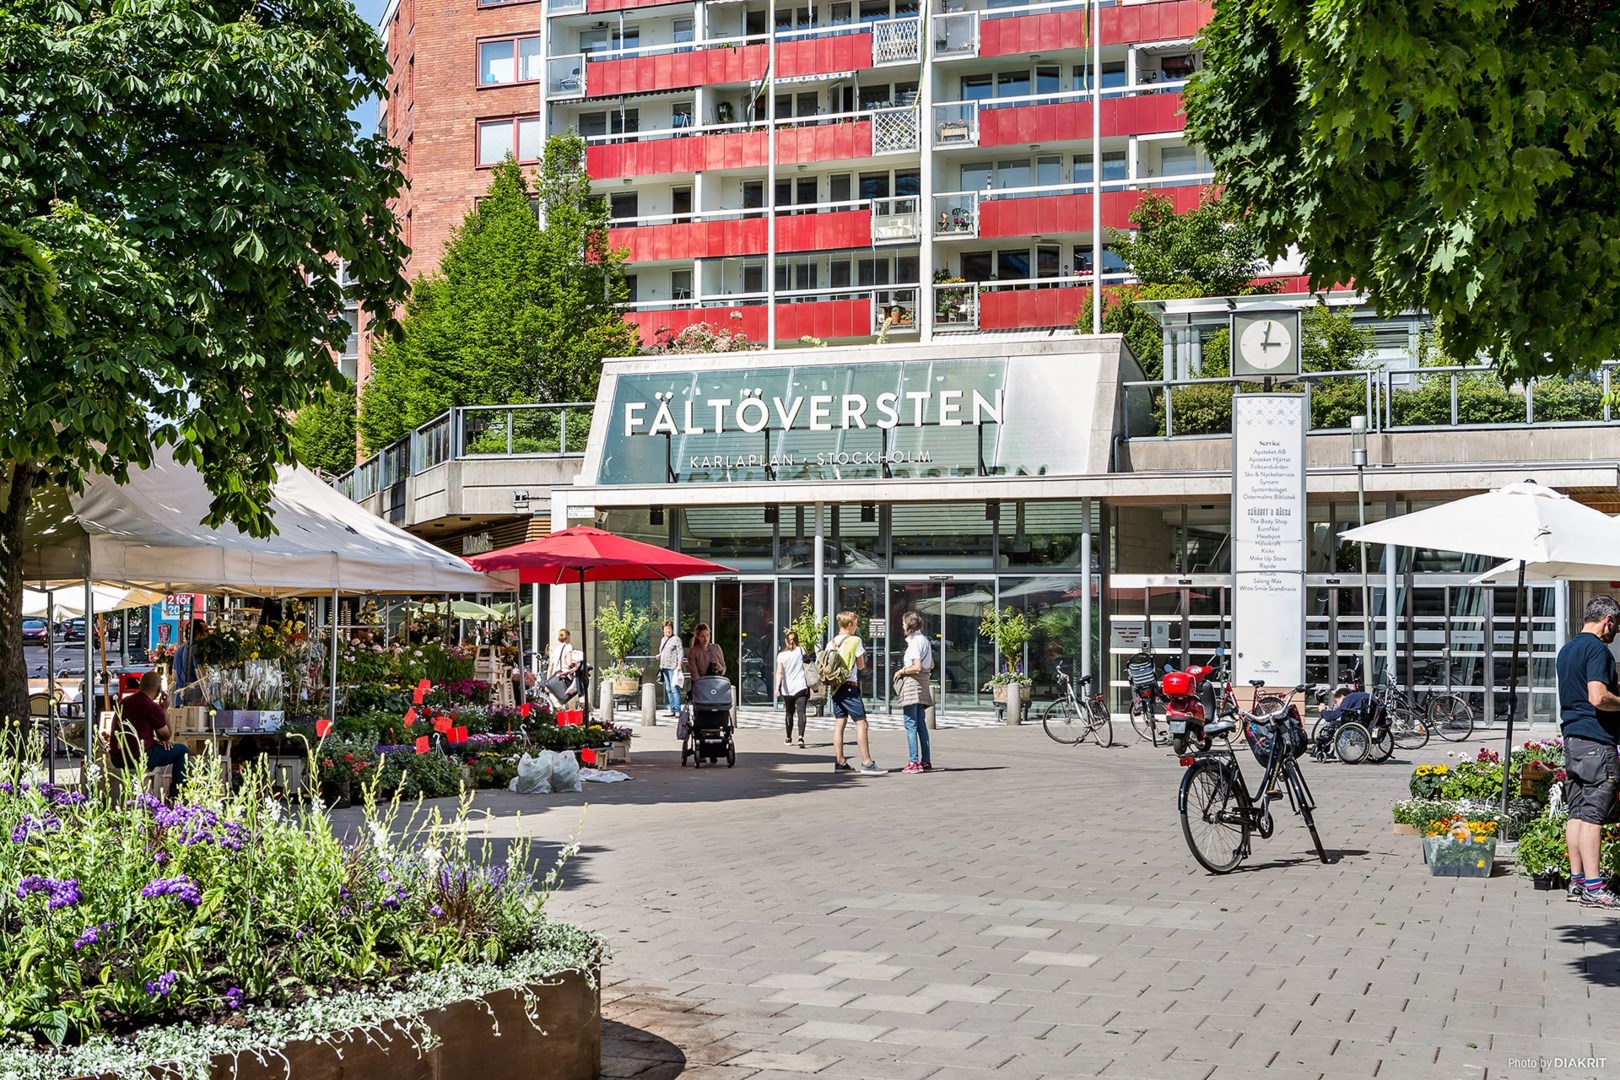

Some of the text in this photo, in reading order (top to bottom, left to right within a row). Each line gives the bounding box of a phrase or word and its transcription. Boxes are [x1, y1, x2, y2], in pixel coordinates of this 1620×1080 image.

[624, 387, 1004, 437] FÄLTÖVERSTEN
[689, 450, 933, 468] KARLAPLAN STOCKHOLM
[1274, 518, 1288, 526] Shop
[167, 595, 175, 605] 2
